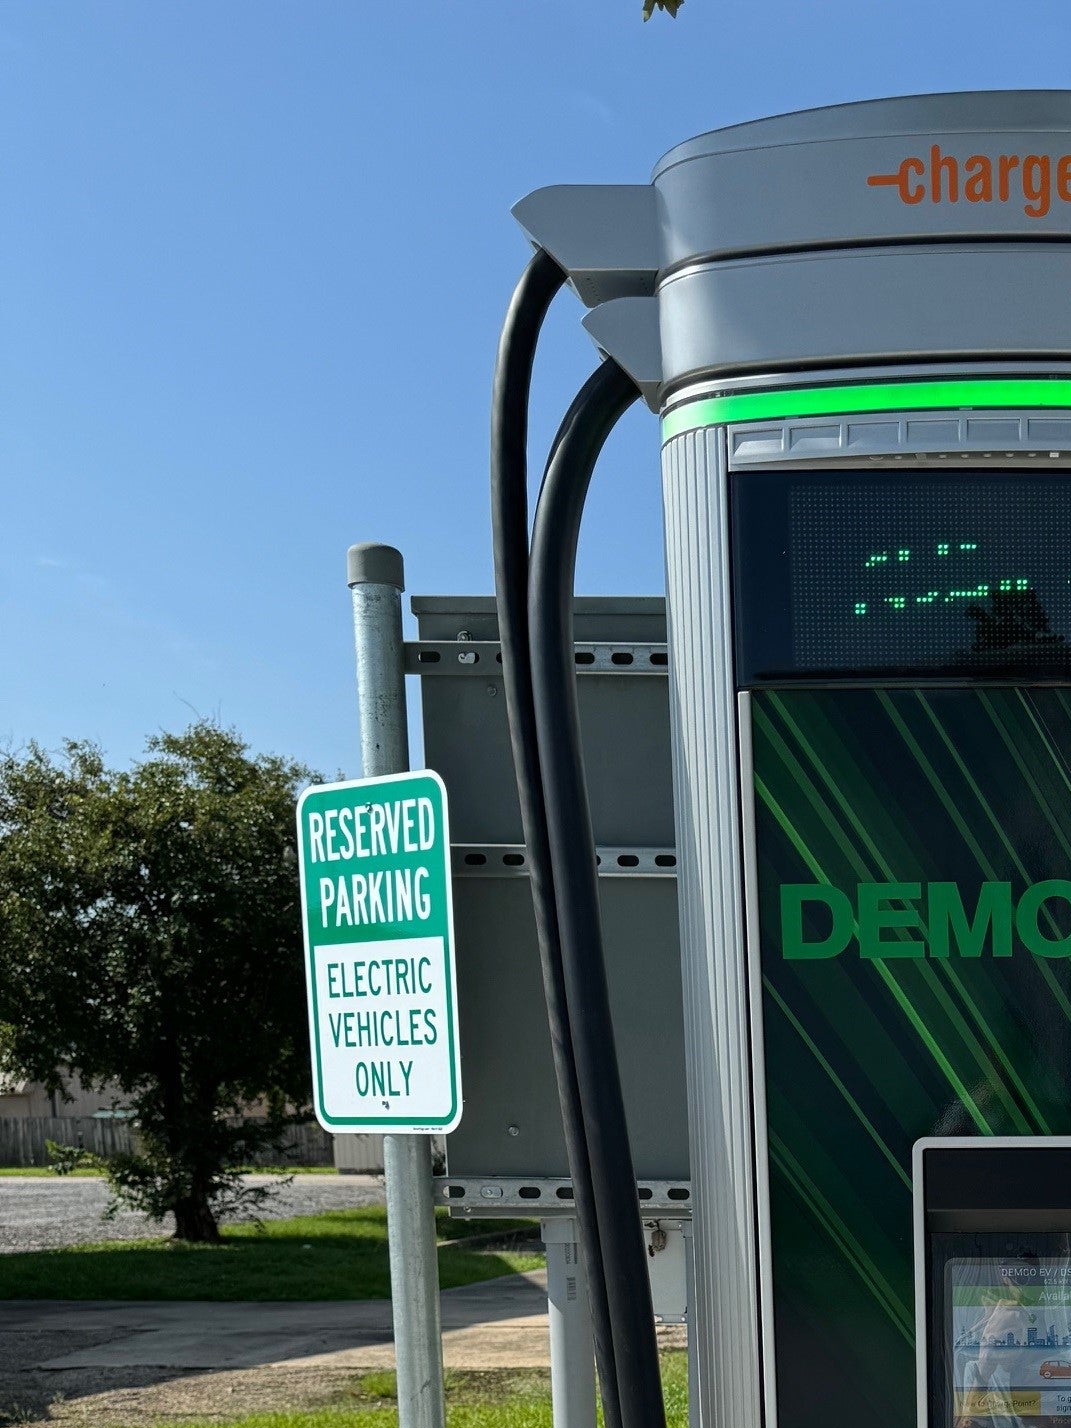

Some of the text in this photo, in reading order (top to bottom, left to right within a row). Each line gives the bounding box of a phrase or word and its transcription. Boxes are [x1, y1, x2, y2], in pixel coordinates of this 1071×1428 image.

[308, 797, 435, 863] RESERVED
[319, 867, 431, 928] PARKING
[327, 957, 433, 999] ELECTRIC
[328, 1008, 438, 1048] VEHICLES
[355, 1061, 414, 1097] ONLY
[1001, 1268, 1037, 1277] DEMCO
[1040, 1268, 1052, 1277] EV
